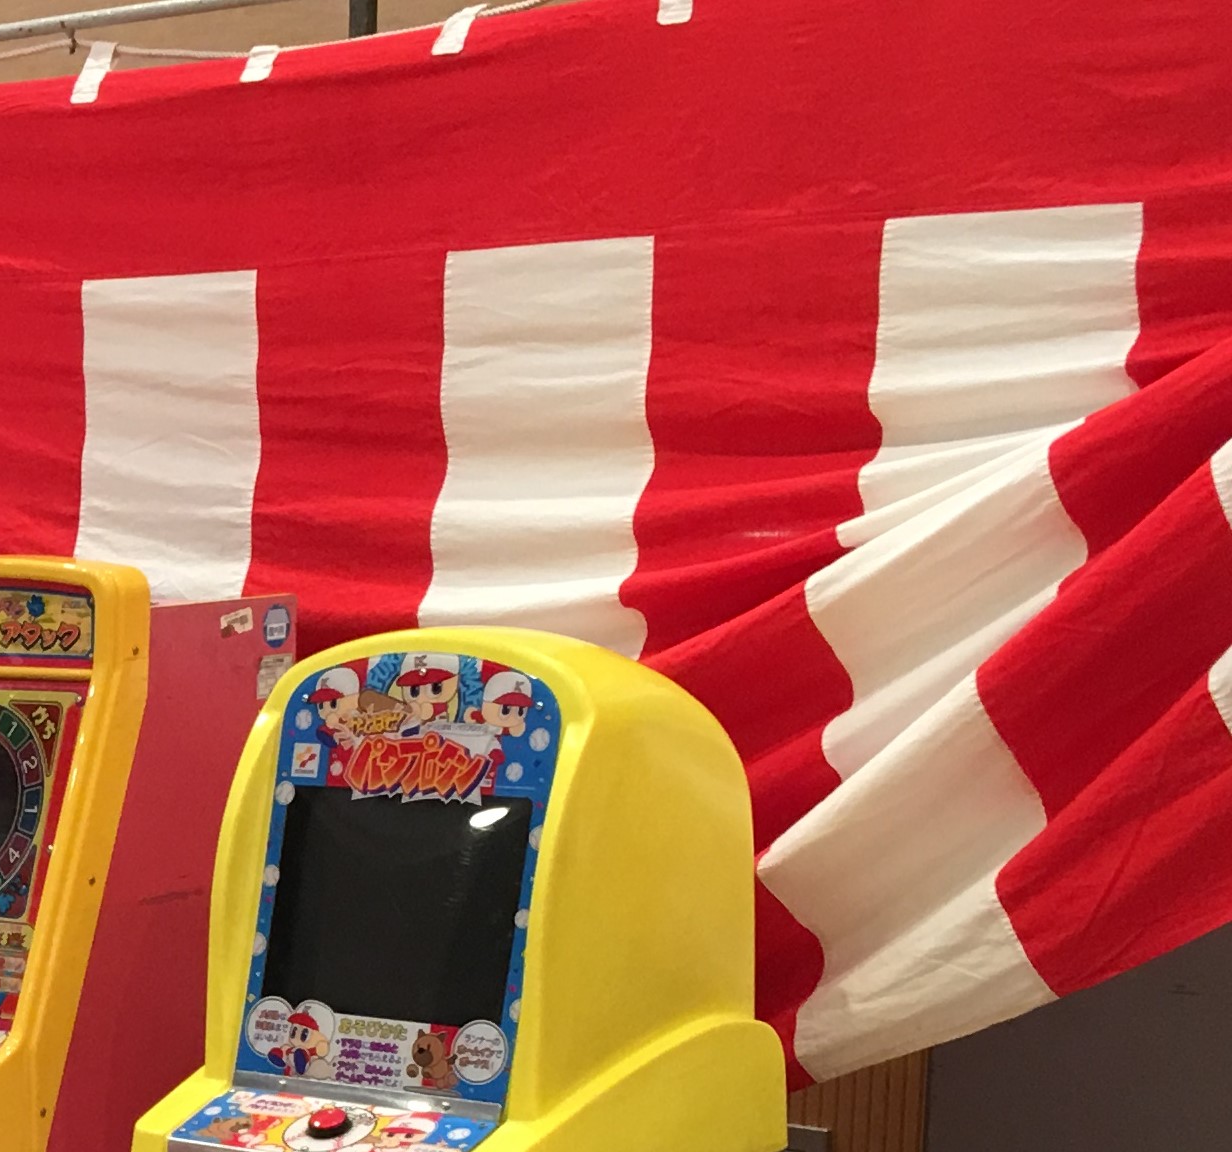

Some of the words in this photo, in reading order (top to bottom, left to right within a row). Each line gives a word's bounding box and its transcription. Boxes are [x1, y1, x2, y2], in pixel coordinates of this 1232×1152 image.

[0, 620, 81, 651] アタック
[7, 720, 18, 738] 1
[22, 755, 38, 774] 2
[344, 731, 491, 797] パワプロクン
[8, 847, 21, 864] 4
